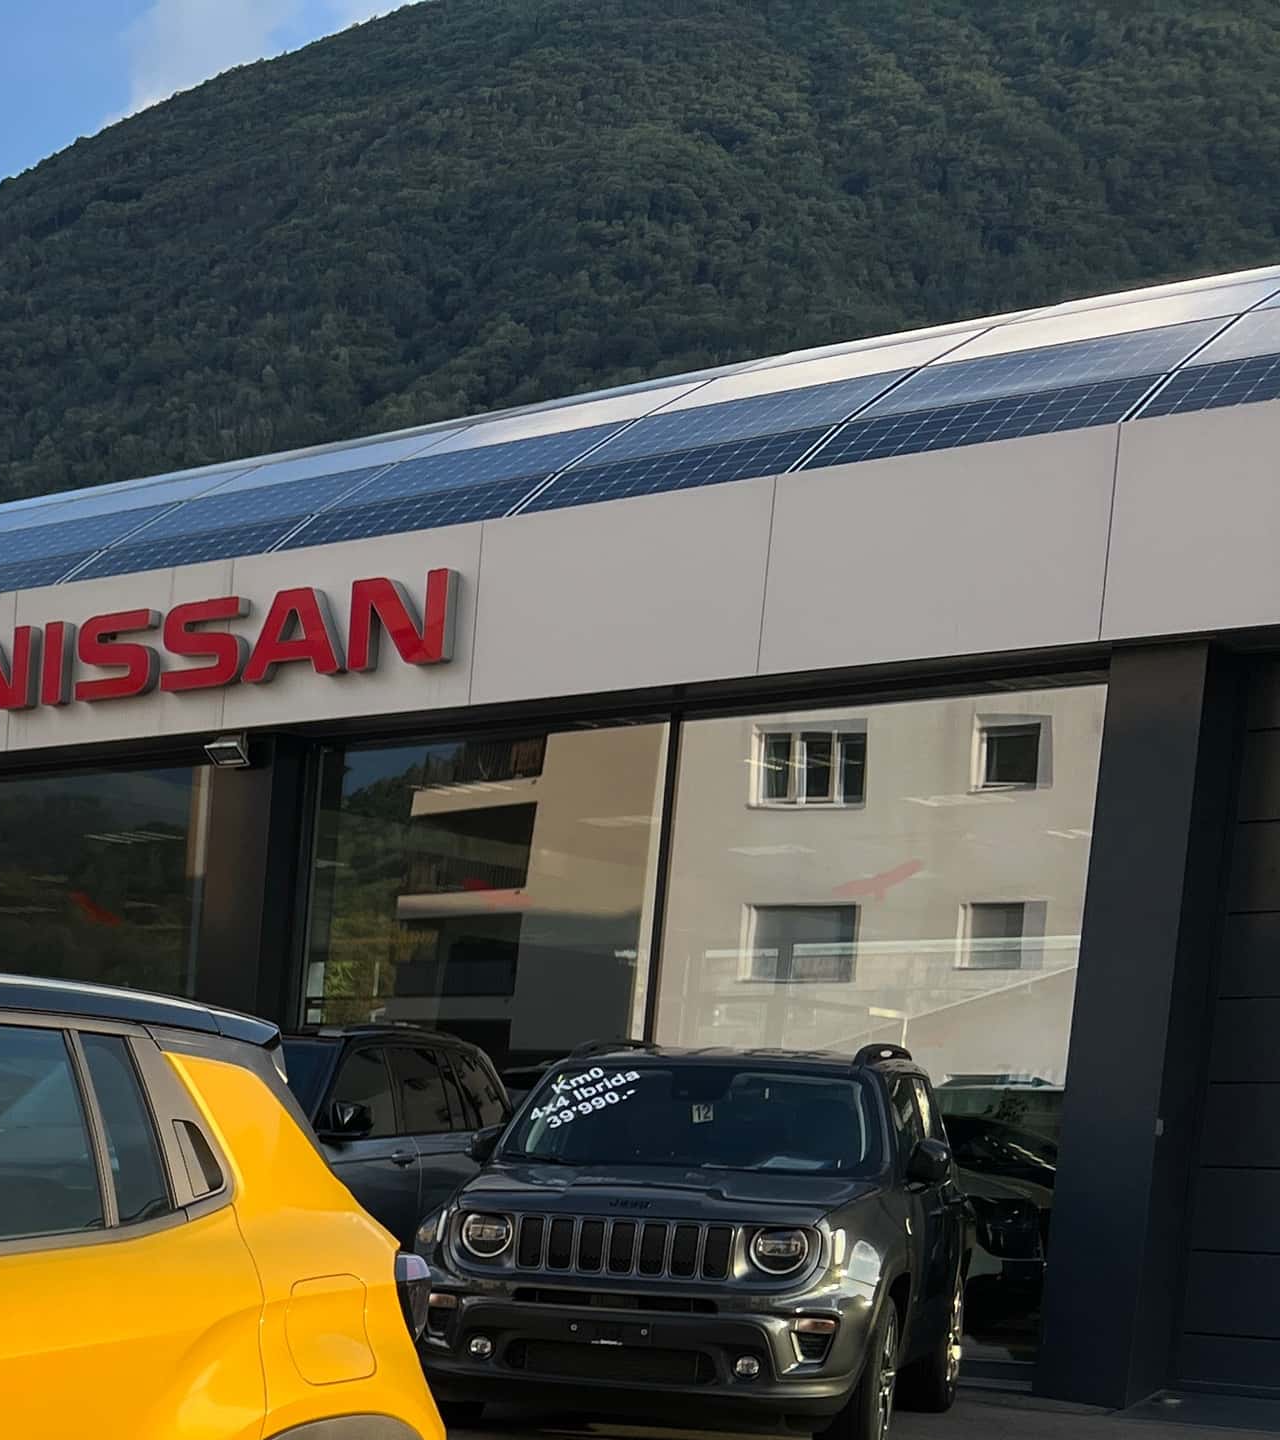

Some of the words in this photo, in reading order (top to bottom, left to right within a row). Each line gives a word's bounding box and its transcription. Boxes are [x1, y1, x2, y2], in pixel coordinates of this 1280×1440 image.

[530, 1096, 570, 1121] 4x4
[573, 1070, 641, 1101] Ibrida
[695, 1105, 712, 1121] 12
